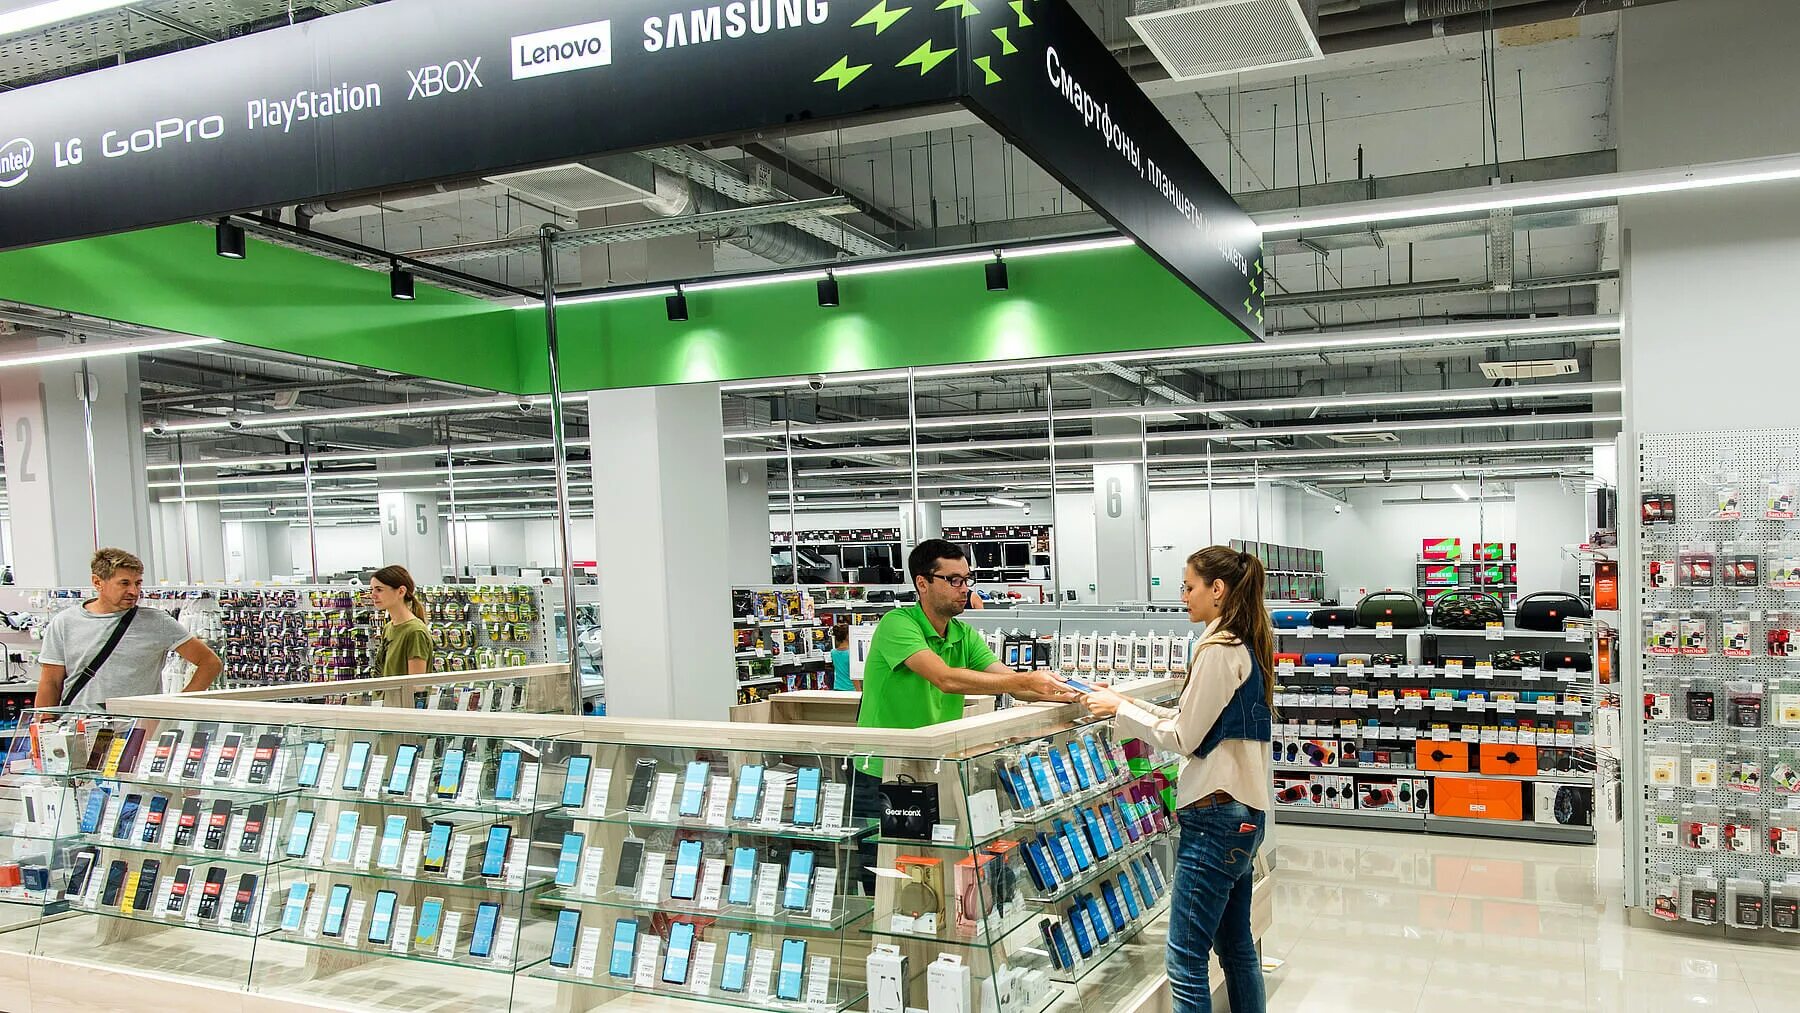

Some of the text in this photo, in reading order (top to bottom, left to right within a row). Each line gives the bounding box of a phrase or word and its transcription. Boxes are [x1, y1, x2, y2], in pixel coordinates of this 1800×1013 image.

[643, 0, 829, 52] SAMSUNG
[520, 35, 602, 67] Lenovo
[407, 57, 483, 101] XBOX
[247, 82, 381, 133] PlayStation
[55, 138, 83, 168] LG
[102, 115, 225, 159] GoPro
[1045, 46, 1145, 179] Смартфоны,
[1147, 157, 1203, 232] планшеты
[16, 416, 36, 482] 2
[1106, 476, 1122, 518] 6
[387, 503, 398, 536] 5
[415, 503, 428, 536] 5
[885, 808, 922, 817] Gear IconX
